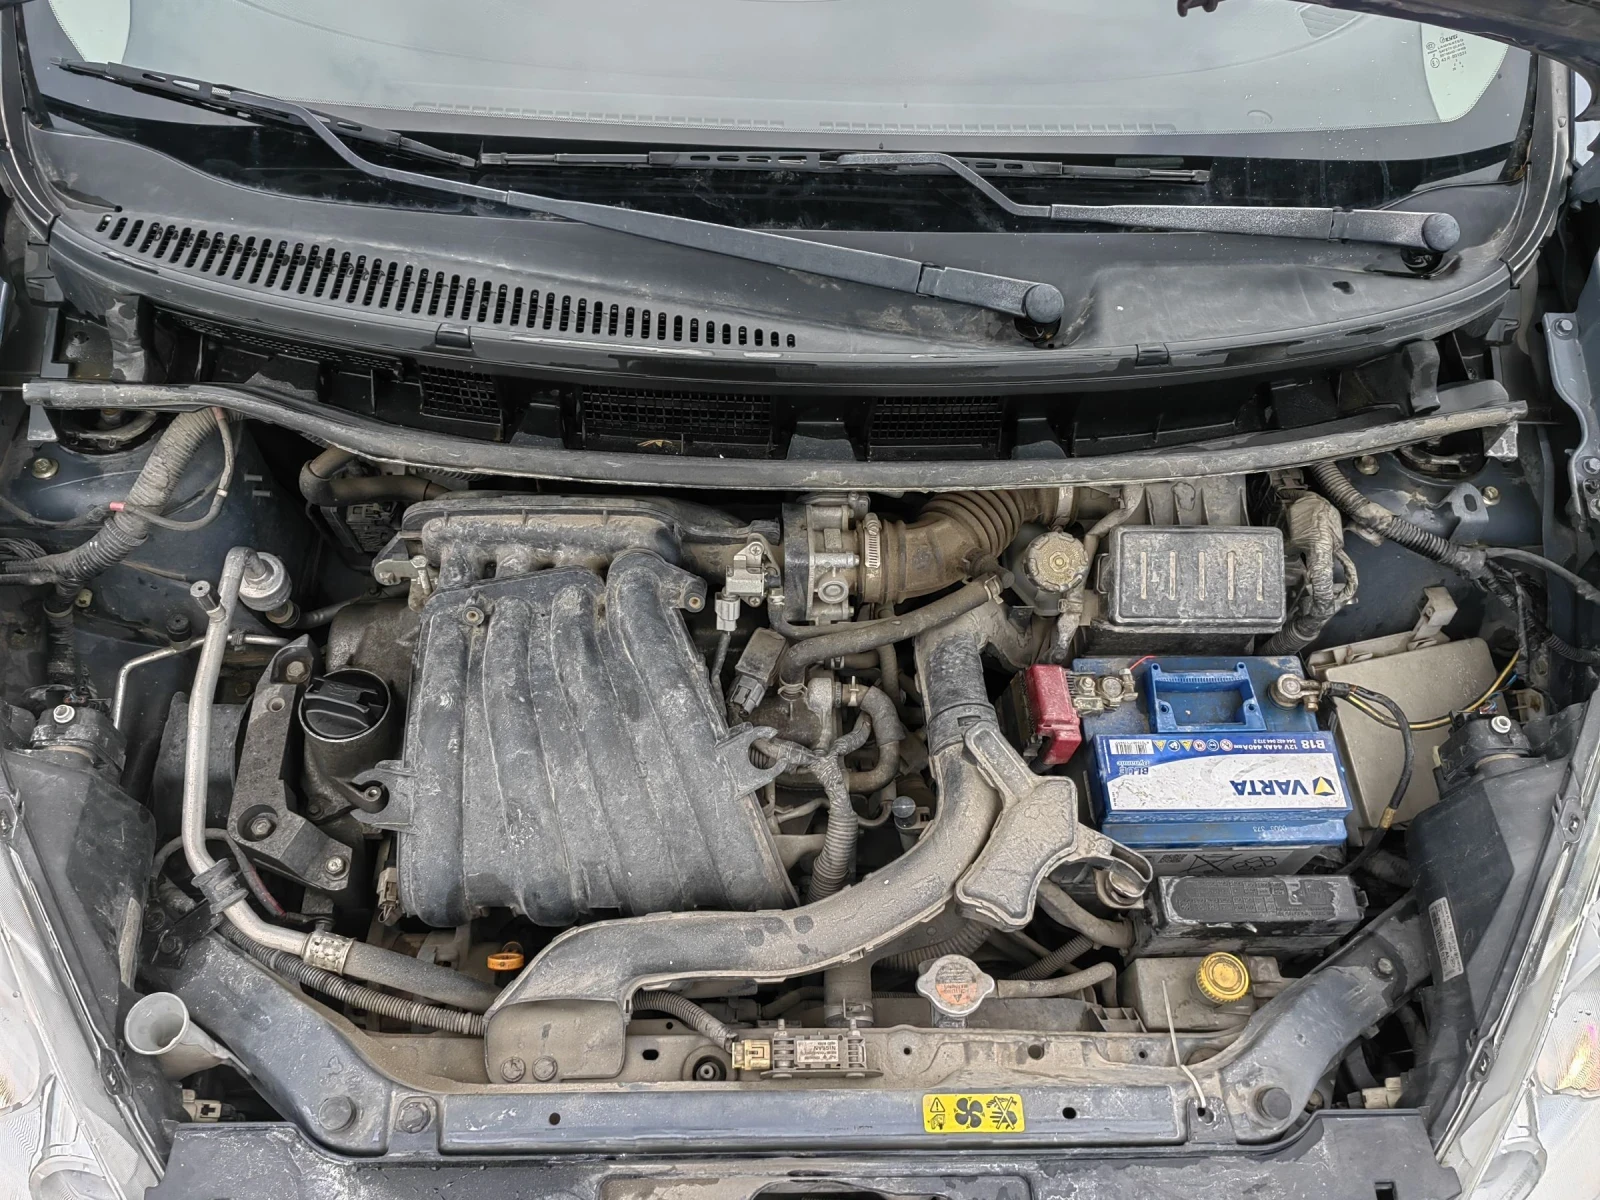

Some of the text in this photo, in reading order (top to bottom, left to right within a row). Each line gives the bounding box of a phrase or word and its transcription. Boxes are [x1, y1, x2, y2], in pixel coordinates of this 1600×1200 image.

[1300, 739, 1326, 750] B18
[1119, 766, 1149, 776] BLUE
[1229, 779, 1310, 796] VARTA
